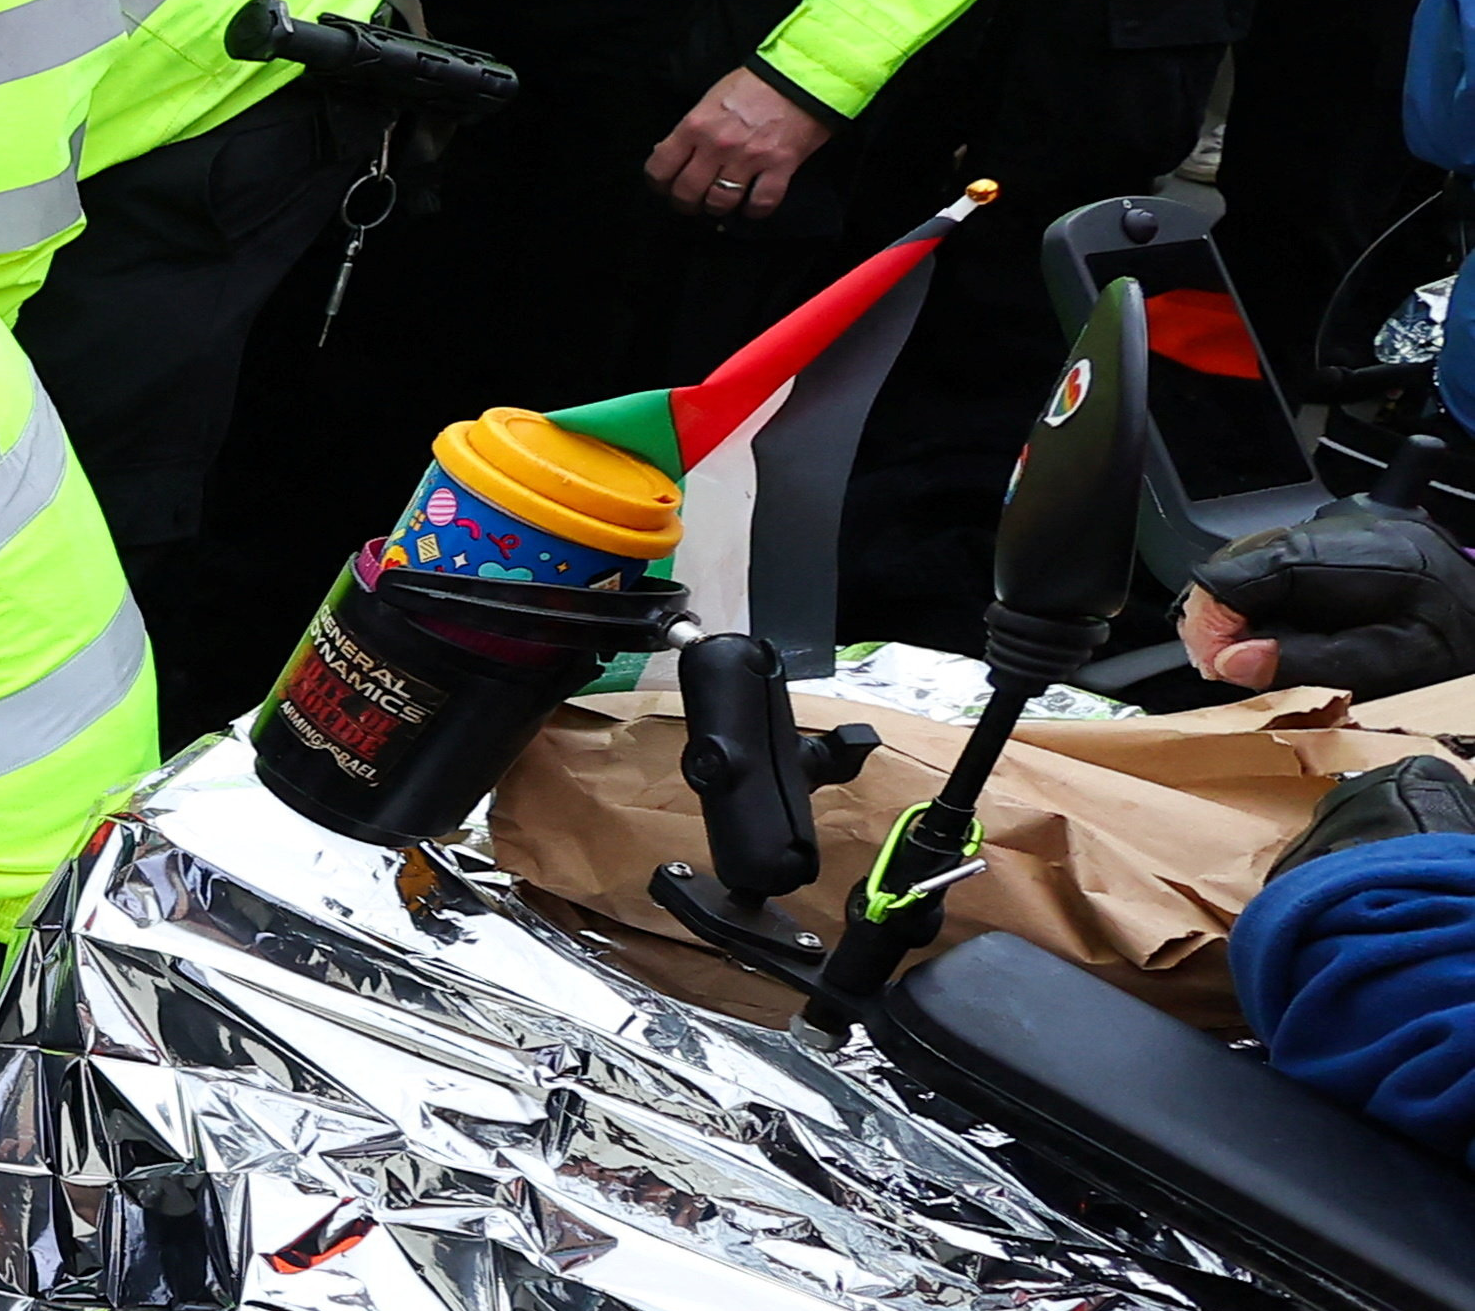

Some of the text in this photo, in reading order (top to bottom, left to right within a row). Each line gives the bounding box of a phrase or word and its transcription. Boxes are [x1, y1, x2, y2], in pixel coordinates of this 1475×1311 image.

[310, 617, 426, 724] DYNAMICS
[318, 604, 411, 699] GENERAL
[280, 700, 325, 746] ARMING
